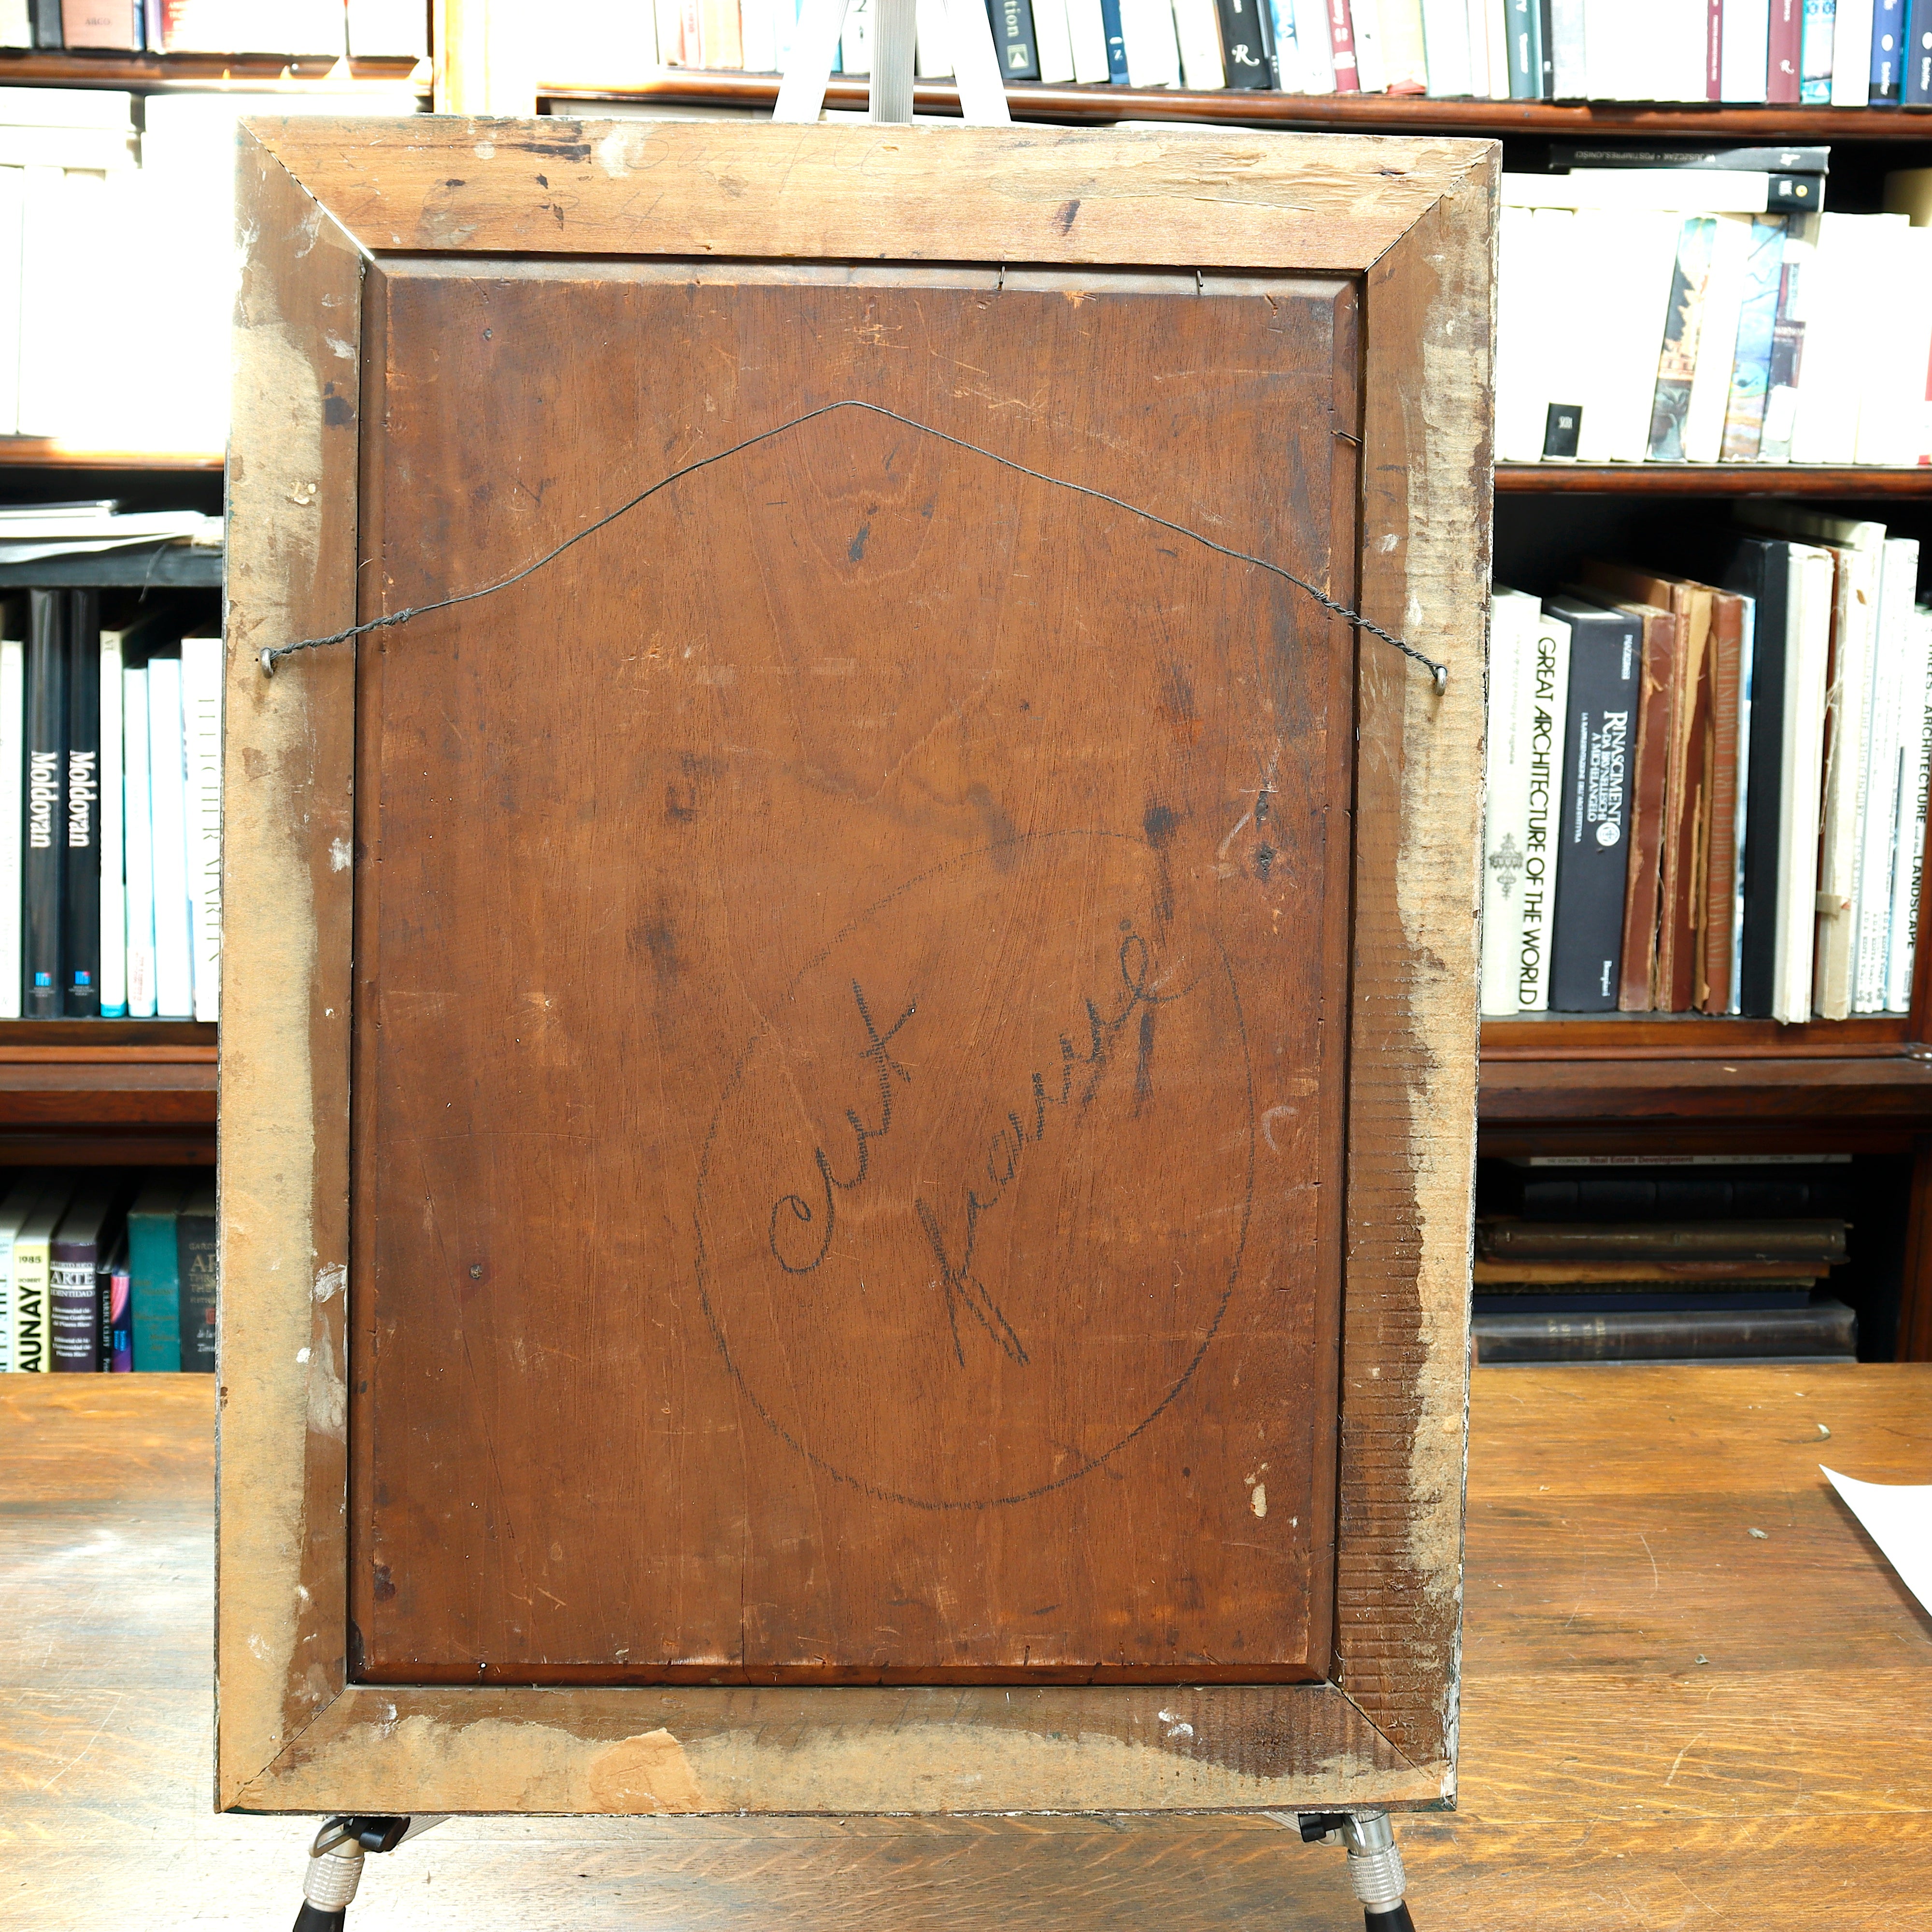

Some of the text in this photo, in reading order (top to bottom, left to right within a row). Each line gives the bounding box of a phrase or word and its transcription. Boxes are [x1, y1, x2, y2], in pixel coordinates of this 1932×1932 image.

[30, 750, 57, 848] Moldovan
[68, 750, 96, 848] Moldovan
[1916, 704, 1932, 824] ARCHITECTURE
[1518, 636, 1557, 1006] GREAT ARCHITECTURE OF THE WORLD
[1907, 855, 1923, 949] LANDSCAPE
[1637, 1155, 1694, 1165] Development
[50, 1271, 95, 1285] ARTE
[18, 1285, 42, 1373] AUNAY
